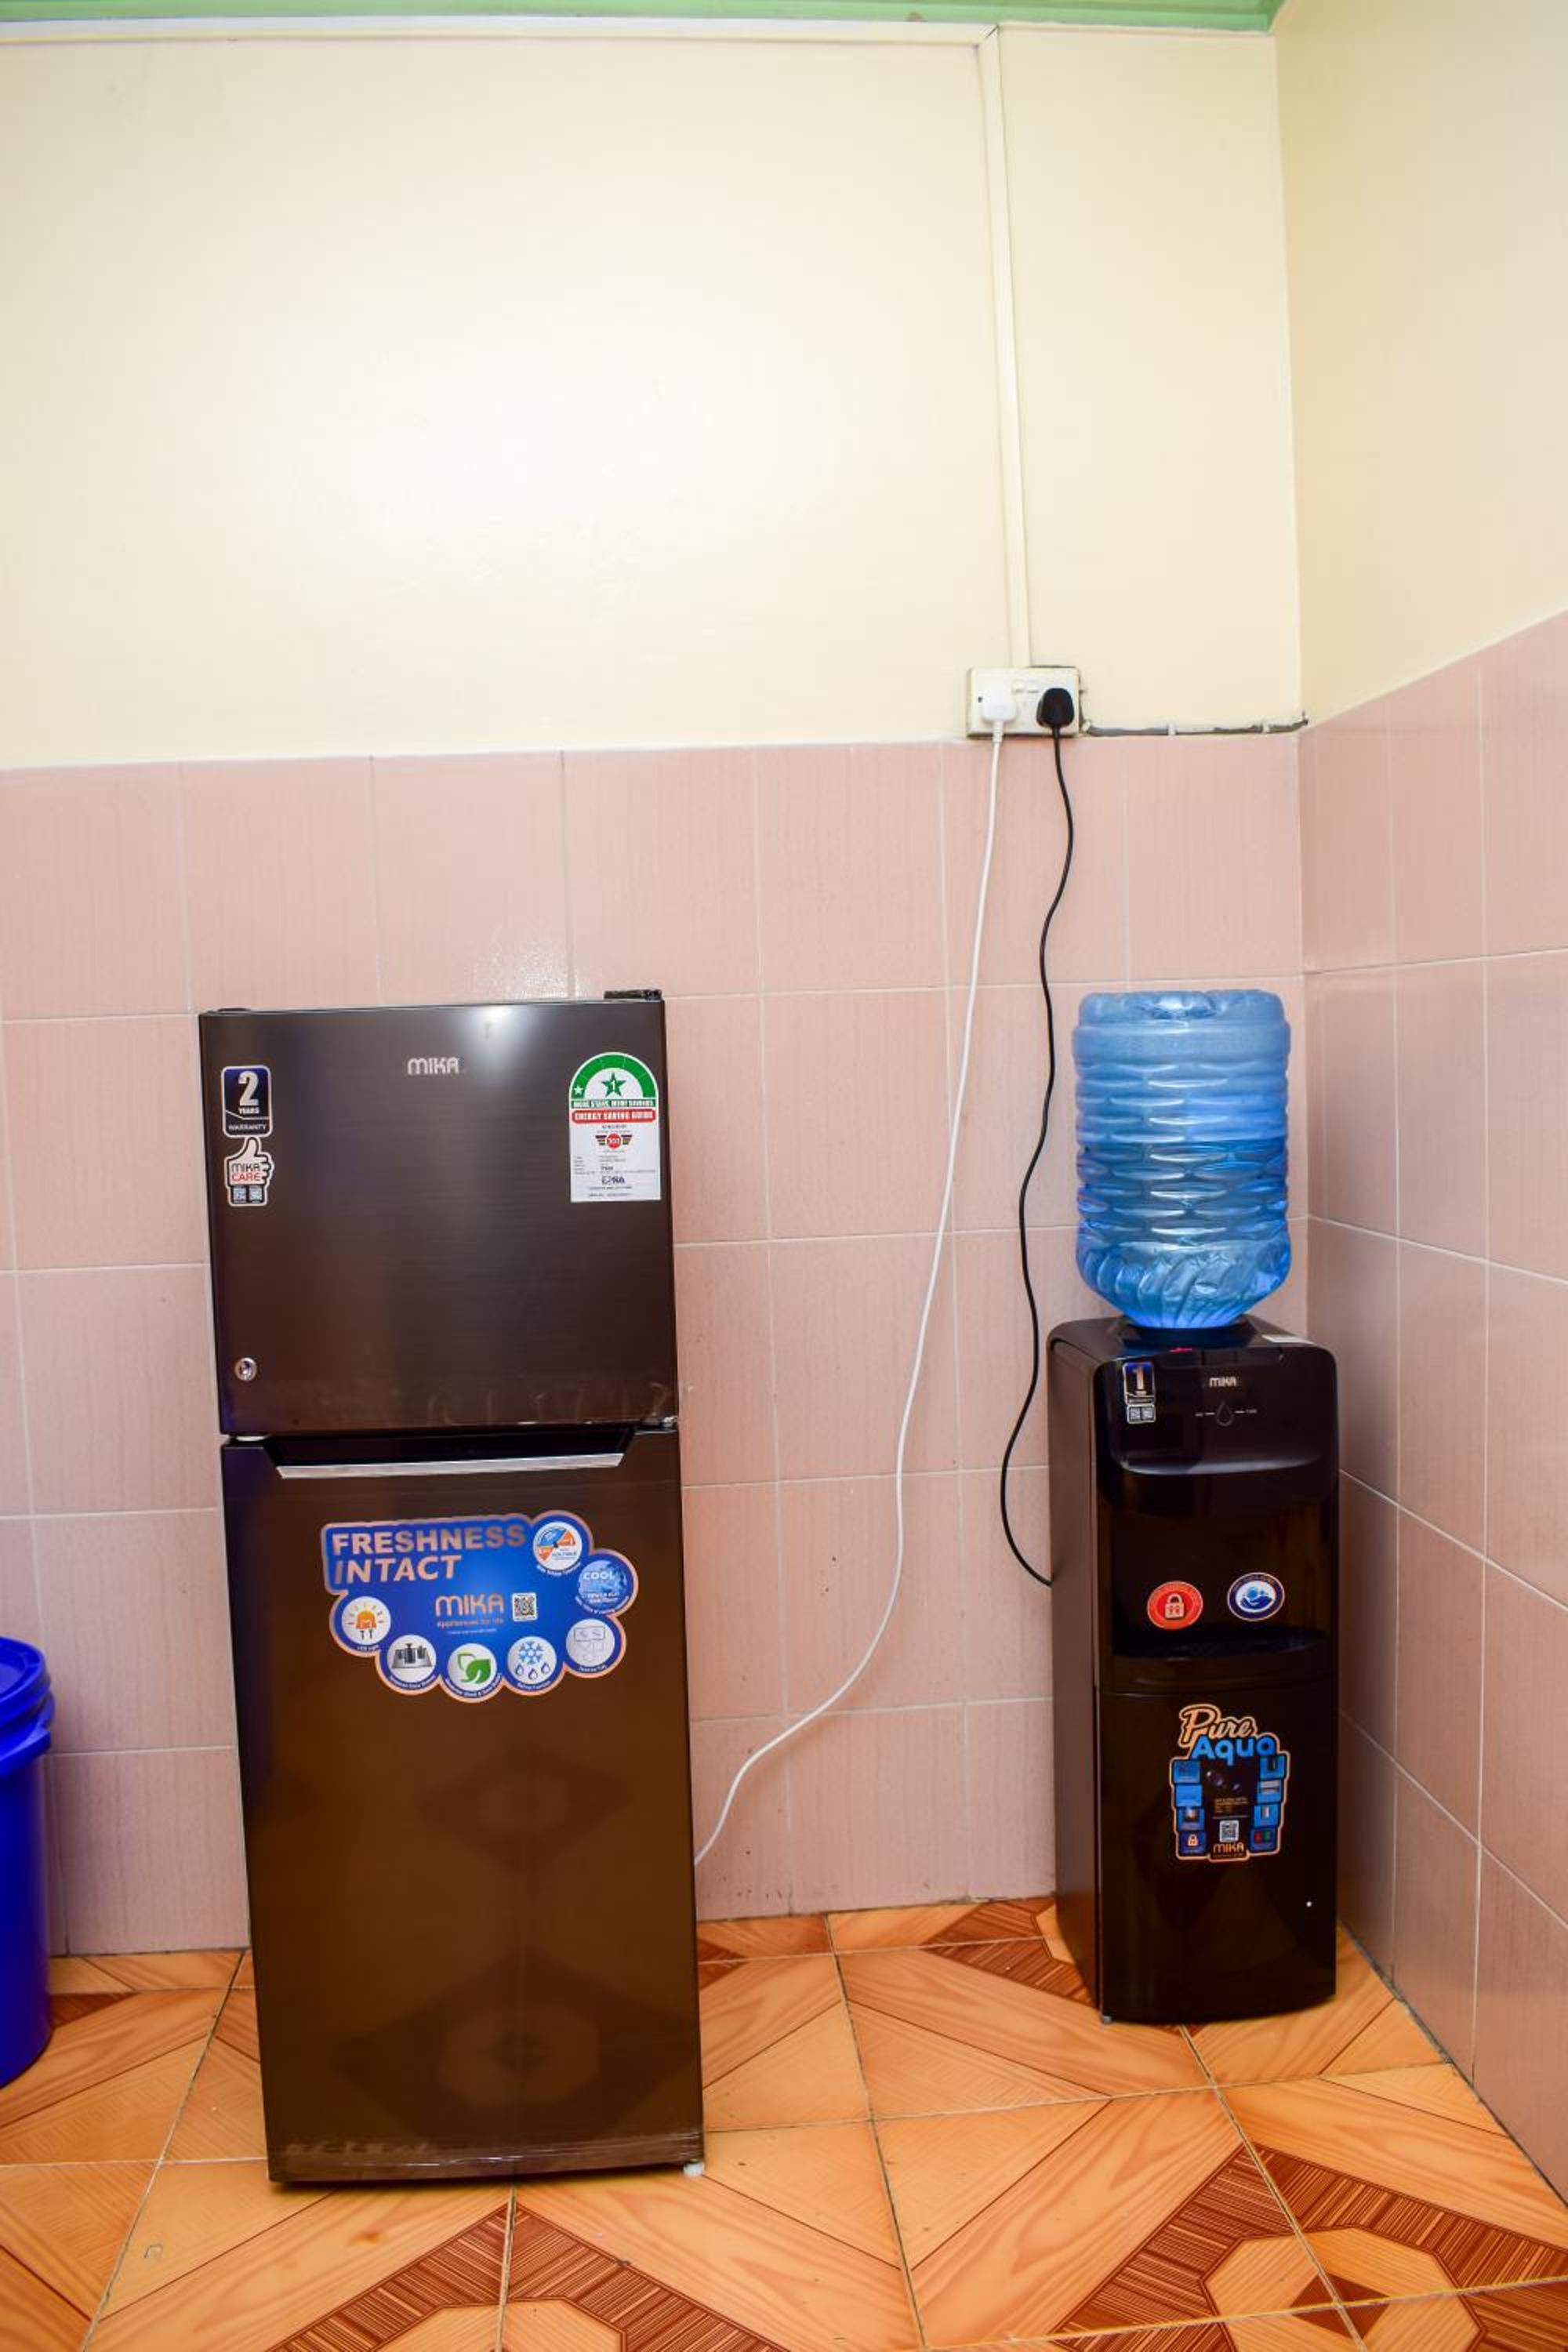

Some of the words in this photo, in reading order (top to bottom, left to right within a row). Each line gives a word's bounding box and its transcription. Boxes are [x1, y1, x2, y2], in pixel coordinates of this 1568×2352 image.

[408, 1058, 459, 1075] MIKA
[238, 1071, 259, 1106] 2
[231, 1163, 260, 1172] MIKA
[231, 1173, 261, 1181] CARE
[1132, 1367, 1144, 1389] 1
[1210, 1376, 1236, 1387] MIKA
[332, 1525, 526, 1555] FRESHNESS
[335, 1555, 462, 1584] INTACT
[583, 1570, 615, 1581] COOL
[435, 1592, 505, 1616] MIKA
[1183, 1708, 1252, 1744] Pure
[1192, 1735, 1276, 1766] Aqua
[1213, 1842, 1245, 1853] MIKA
